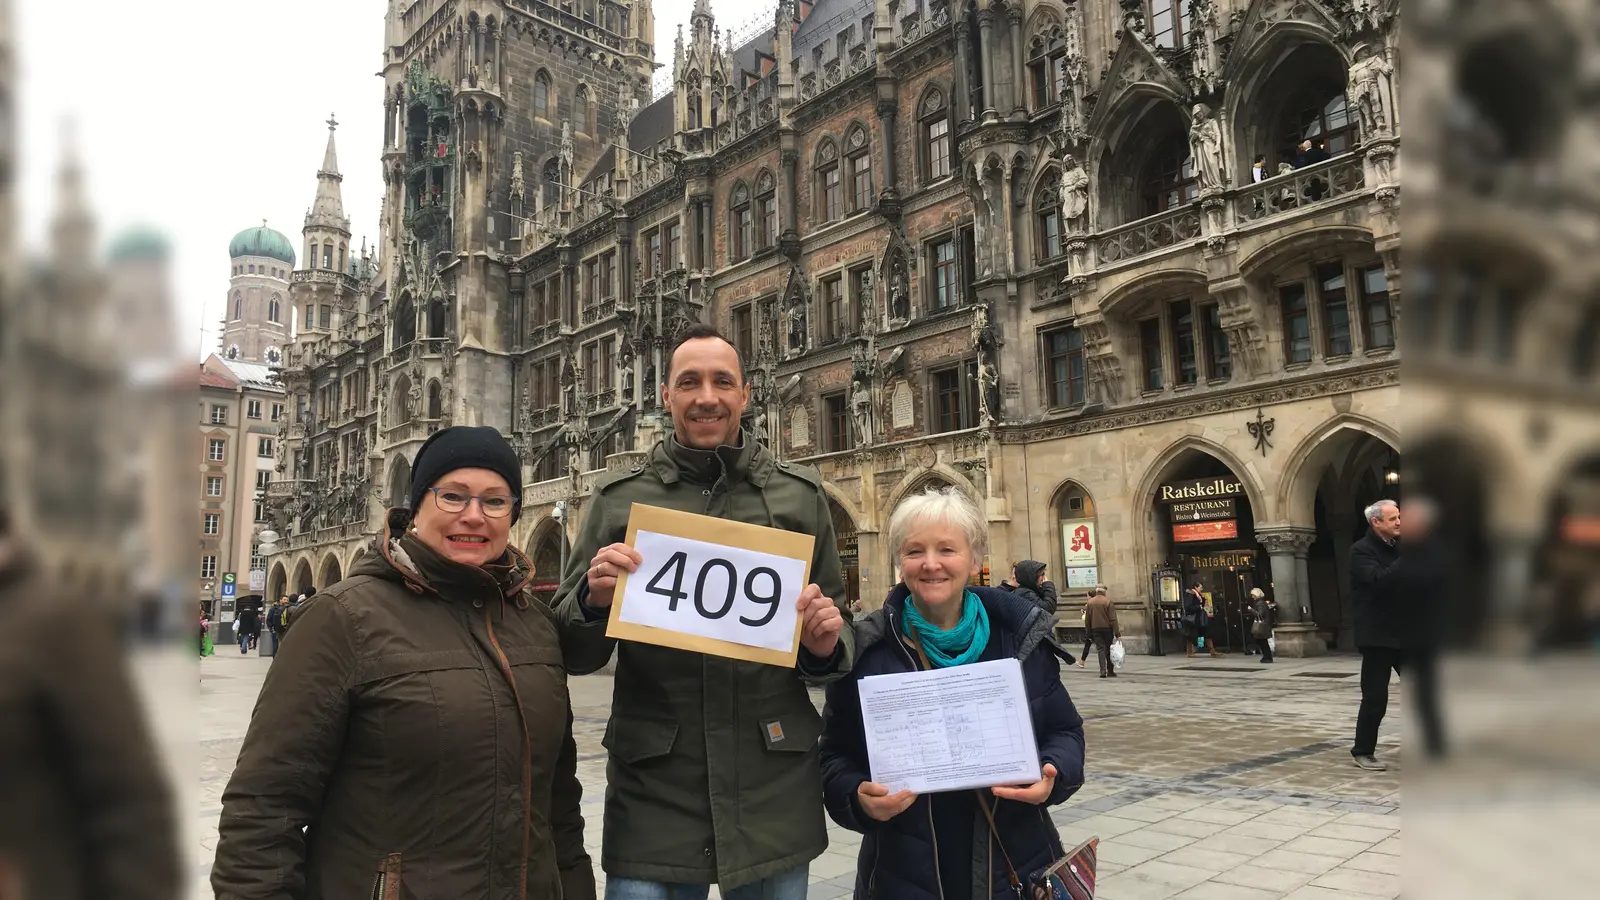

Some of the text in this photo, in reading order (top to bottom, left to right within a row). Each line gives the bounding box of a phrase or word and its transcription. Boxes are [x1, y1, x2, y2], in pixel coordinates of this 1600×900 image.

[1161, 480, 1242, 500] Ratskeller
[1174, 500, 1231, 512] RESTAURANT
[1176, 510, 1231, 521] Bistro Weinstube
[225, 573, 234, 583] S
[224, 585, 232, 594] U
[645, 551, 782, 627] 409
